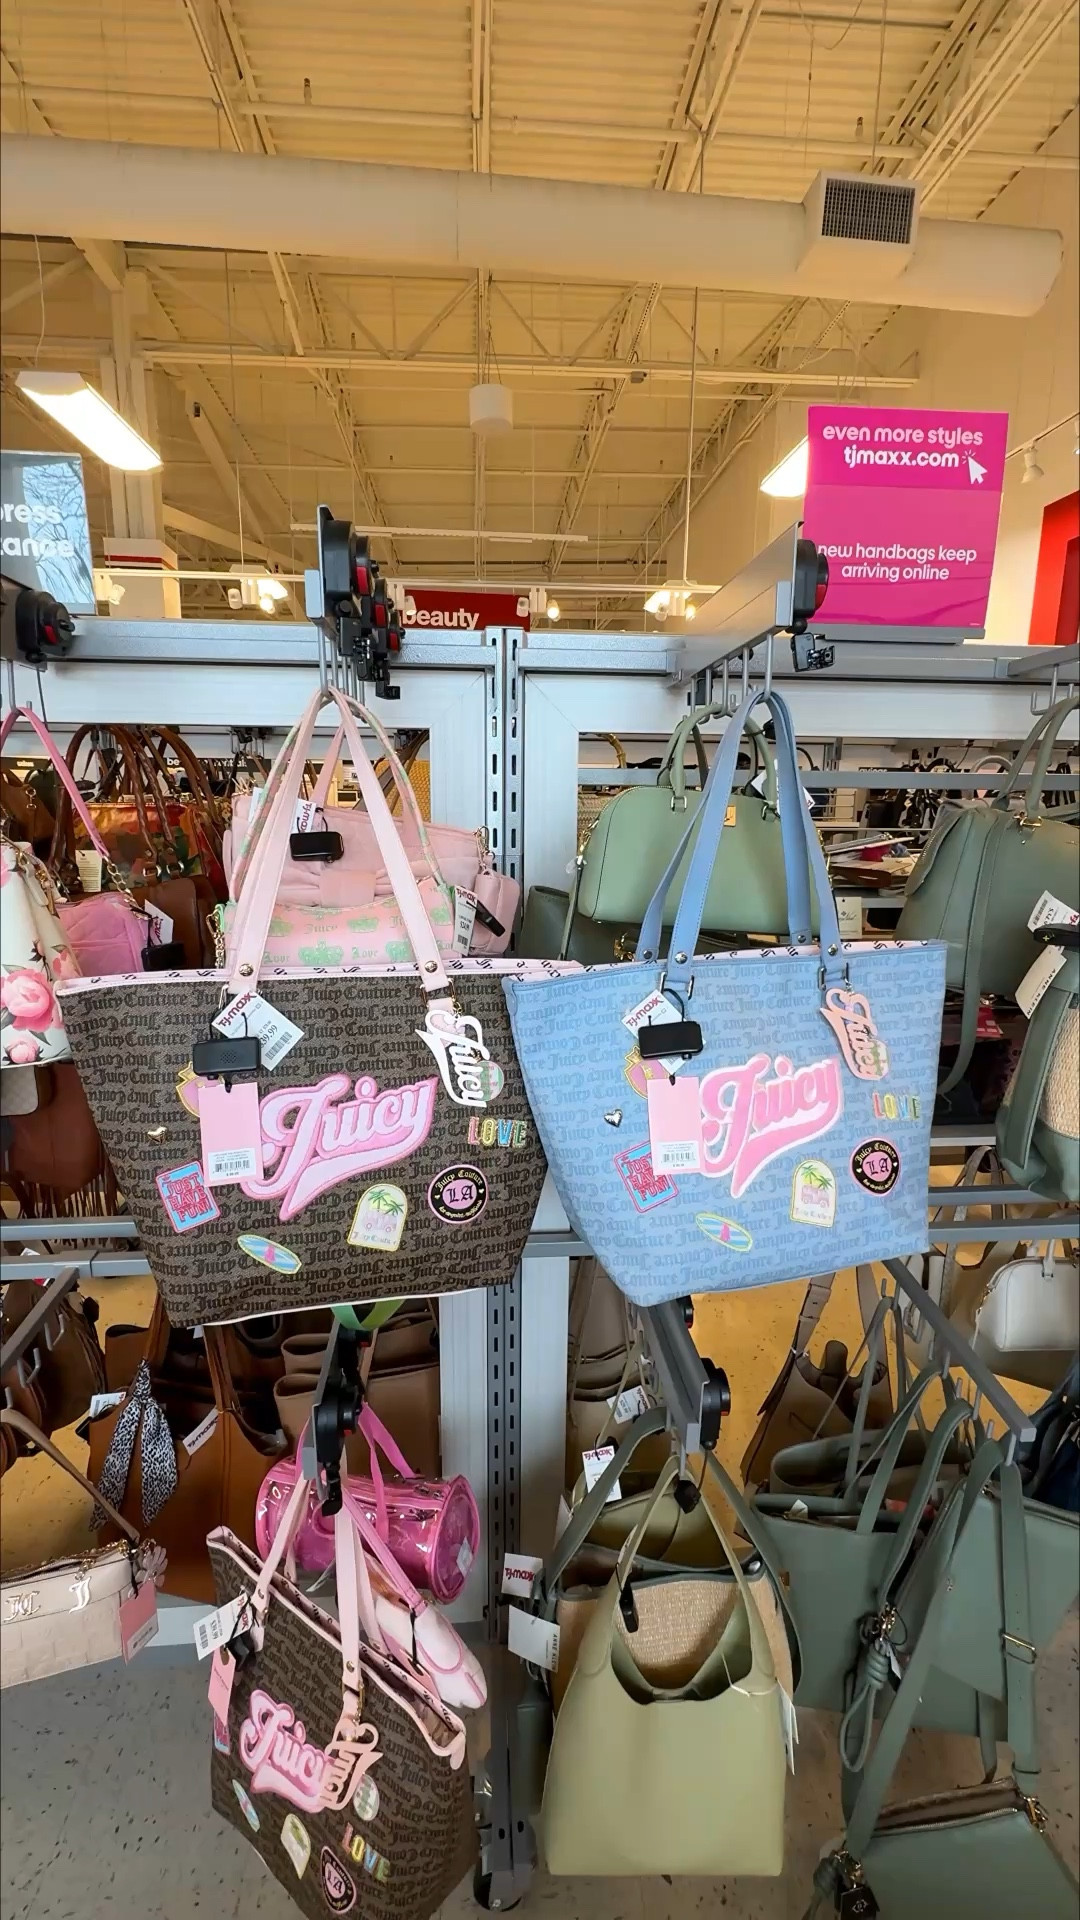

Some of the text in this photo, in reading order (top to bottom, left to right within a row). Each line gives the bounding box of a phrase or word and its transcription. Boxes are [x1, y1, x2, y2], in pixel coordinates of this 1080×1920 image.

[823, 425, 983, 448] even more styles
[844, 445, 959, 468] tjmaxx.com
[1, 503, 62, 524] ress
[817, 543, 977, 565] new handbags keep
[841, 563, 949, 582] arriving online
[402, 608, 479, 630] beauty
[1041, 968, 1056, 991] ANNE
[820, 988, 881, 1080] Juicy
[415, 1009, 490, 1108] Juicy
[872, 1091, 921, 1120] LOVE
[468, 1116, 528, 1148] LOVE
[700, 1053, 844, 1198] Juicy
[241, 1073, 439, 1221] Juicy
[854, 1142, 897, 1166] Juicy Couture
[865, 1157, 890, 1176] LA
[162, 1172, 200, 1195] JUST
[435, 1169, 483, 1192] Juicy Couture
[166, 1185, 206, 1211] HAVE
[445, 1184, 474, 1204] LA
[342, 1822, 391, 1882] LOVE
